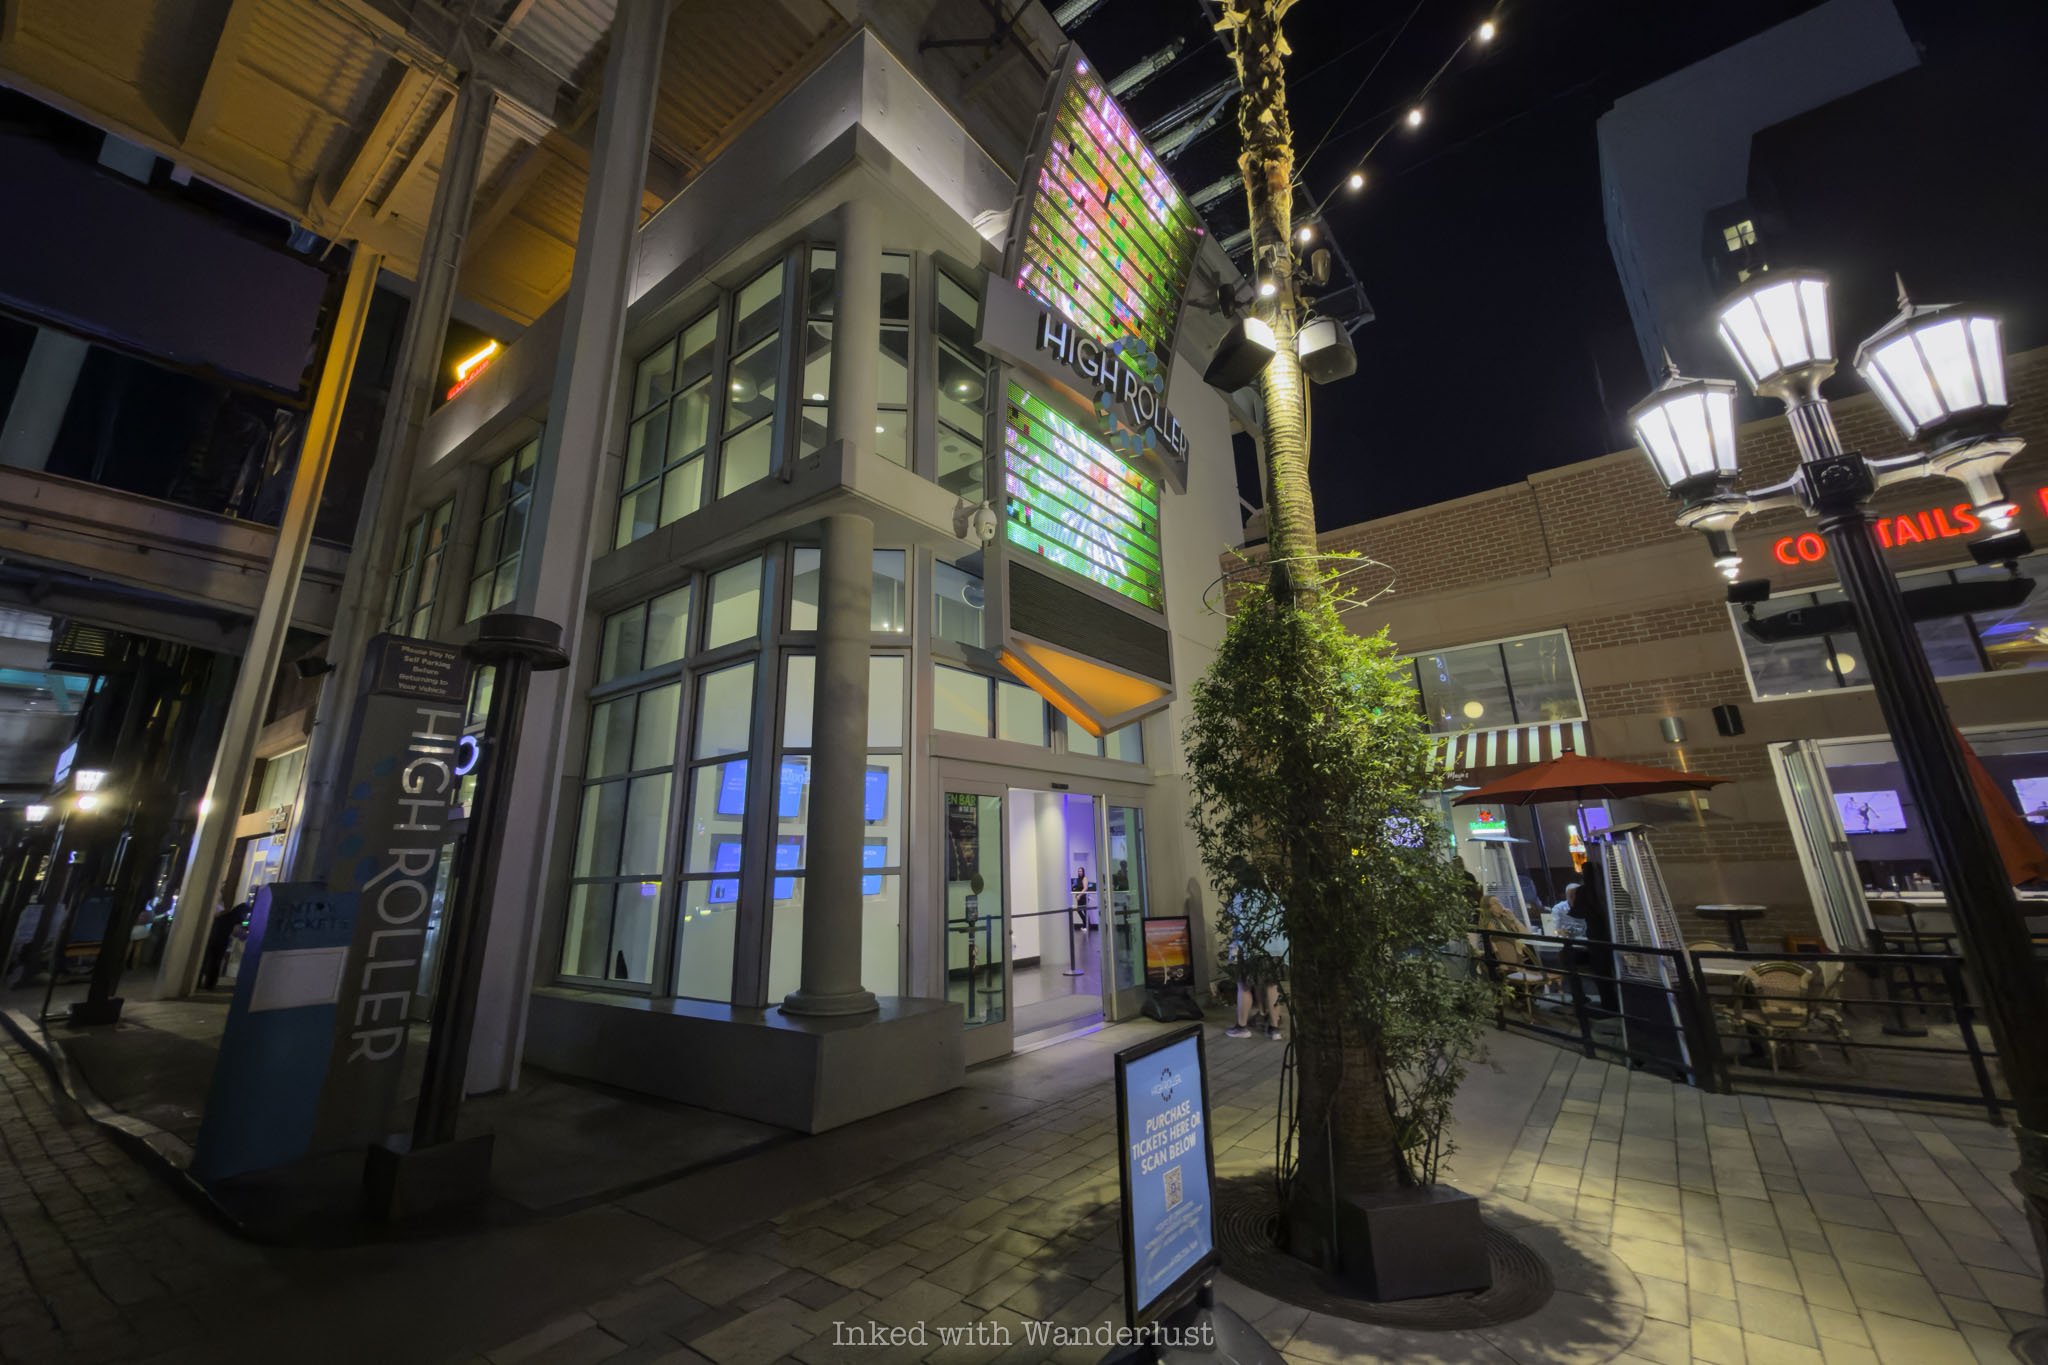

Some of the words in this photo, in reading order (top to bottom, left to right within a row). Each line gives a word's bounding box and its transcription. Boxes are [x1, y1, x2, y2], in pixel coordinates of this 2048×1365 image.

[1043, 312, 1119, 393] HIGH
[1124, 370, 1187, 462] ROLLER
[1773, 503, 1981, 565] COTAILS
[392, 707, 461, 831] HIGH
[346, 848, 437, 1064] ROLLER
[1132, 1129, 1168, 1161] TICKETS
[1169, 1118, 1190, 1141] HERE
[1190, 1111, 1201, 1129] OR
[1146, 1099, 1191, 1135] PURCHASE
[1140, 1150, 1167, 1175] SCAN
[1168, 1131, 1197, 1161] BELOW
